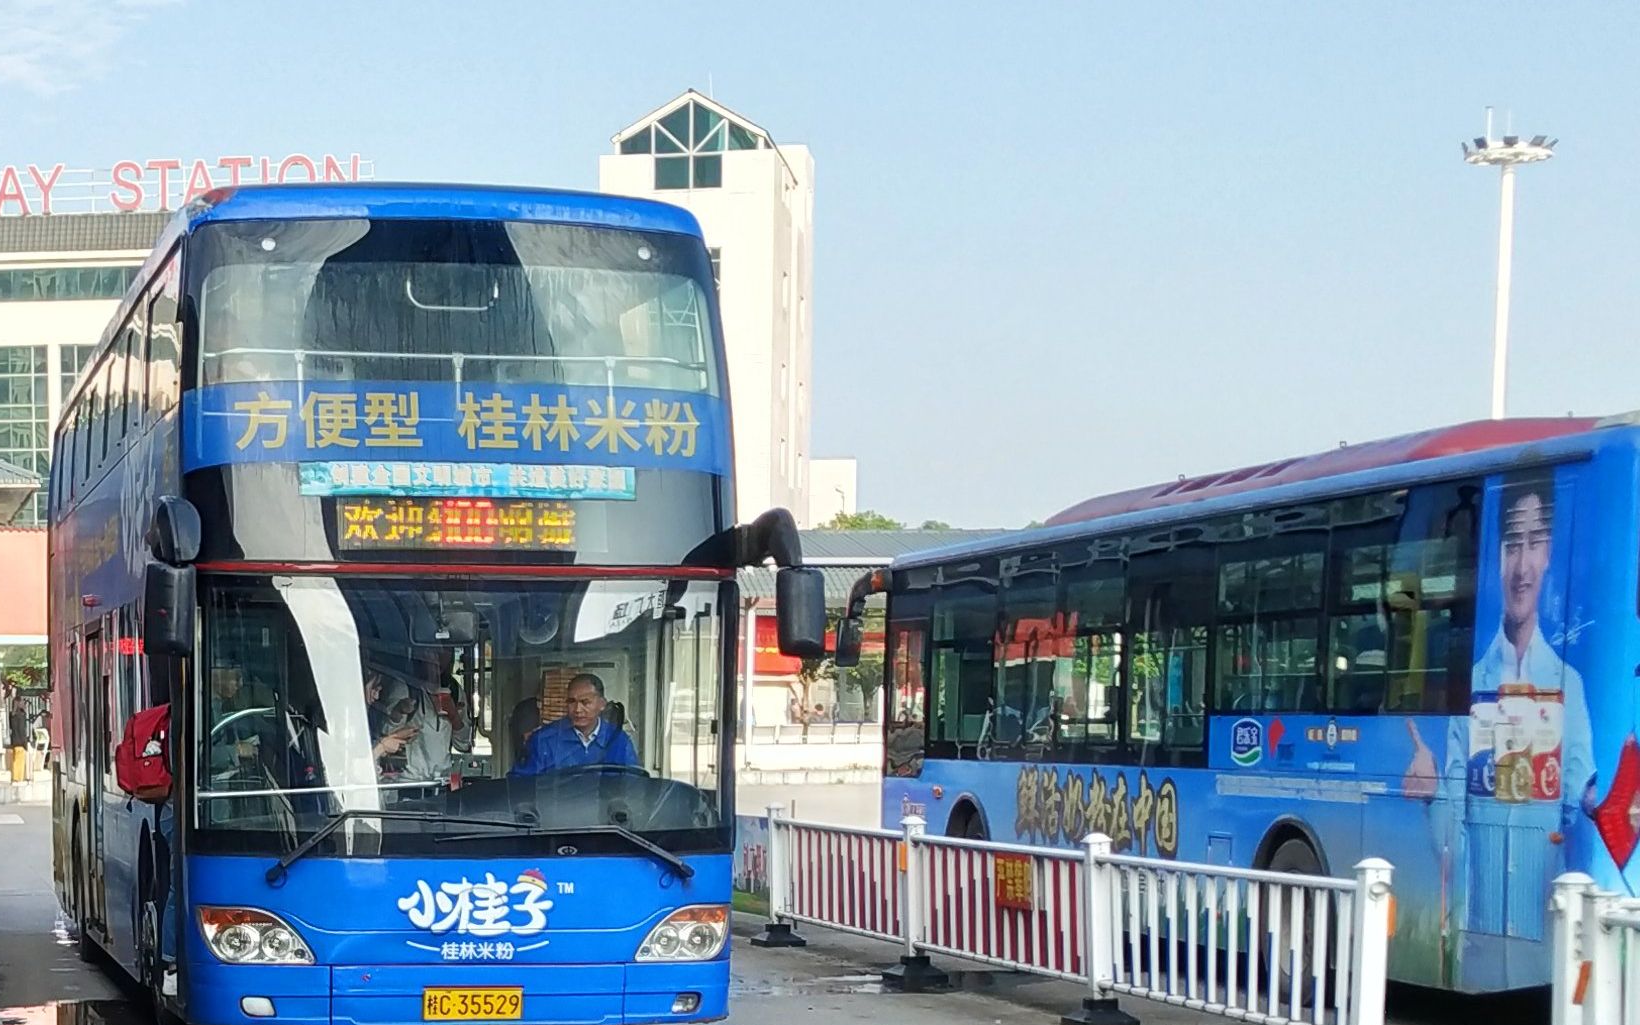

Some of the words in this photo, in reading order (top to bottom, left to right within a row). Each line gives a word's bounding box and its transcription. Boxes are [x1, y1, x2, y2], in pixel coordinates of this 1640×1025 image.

[110, 154, 361, 212] STATION
[234, 391, 424, 450] 方便型
[457, 391, 701, 457] 桂林米粉
[398, 872, 553, 937] 小桂子
[557, 882, 574, 894] TM
[441, 942, 515, 960] 桂林米粉
